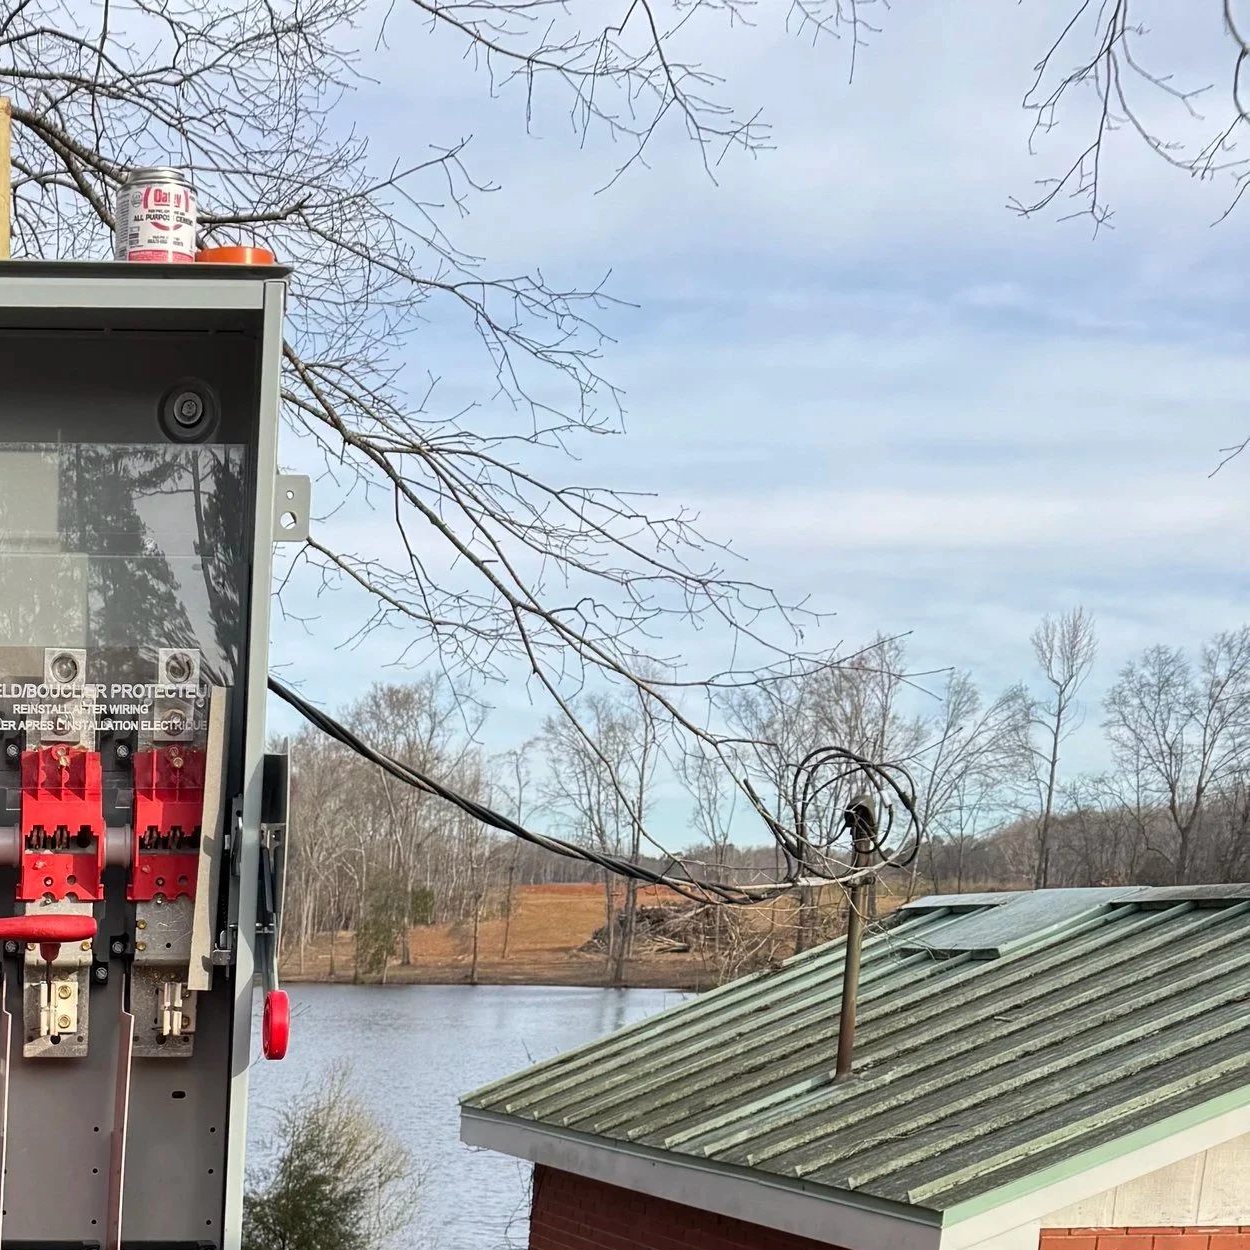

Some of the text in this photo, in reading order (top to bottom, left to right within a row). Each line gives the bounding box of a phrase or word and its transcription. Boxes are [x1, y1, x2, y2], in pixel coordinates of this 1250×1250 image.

[145, 213, 174, 221] PURPO
[12, 704, 149, 715] REINSTALL AFTER WIRING
